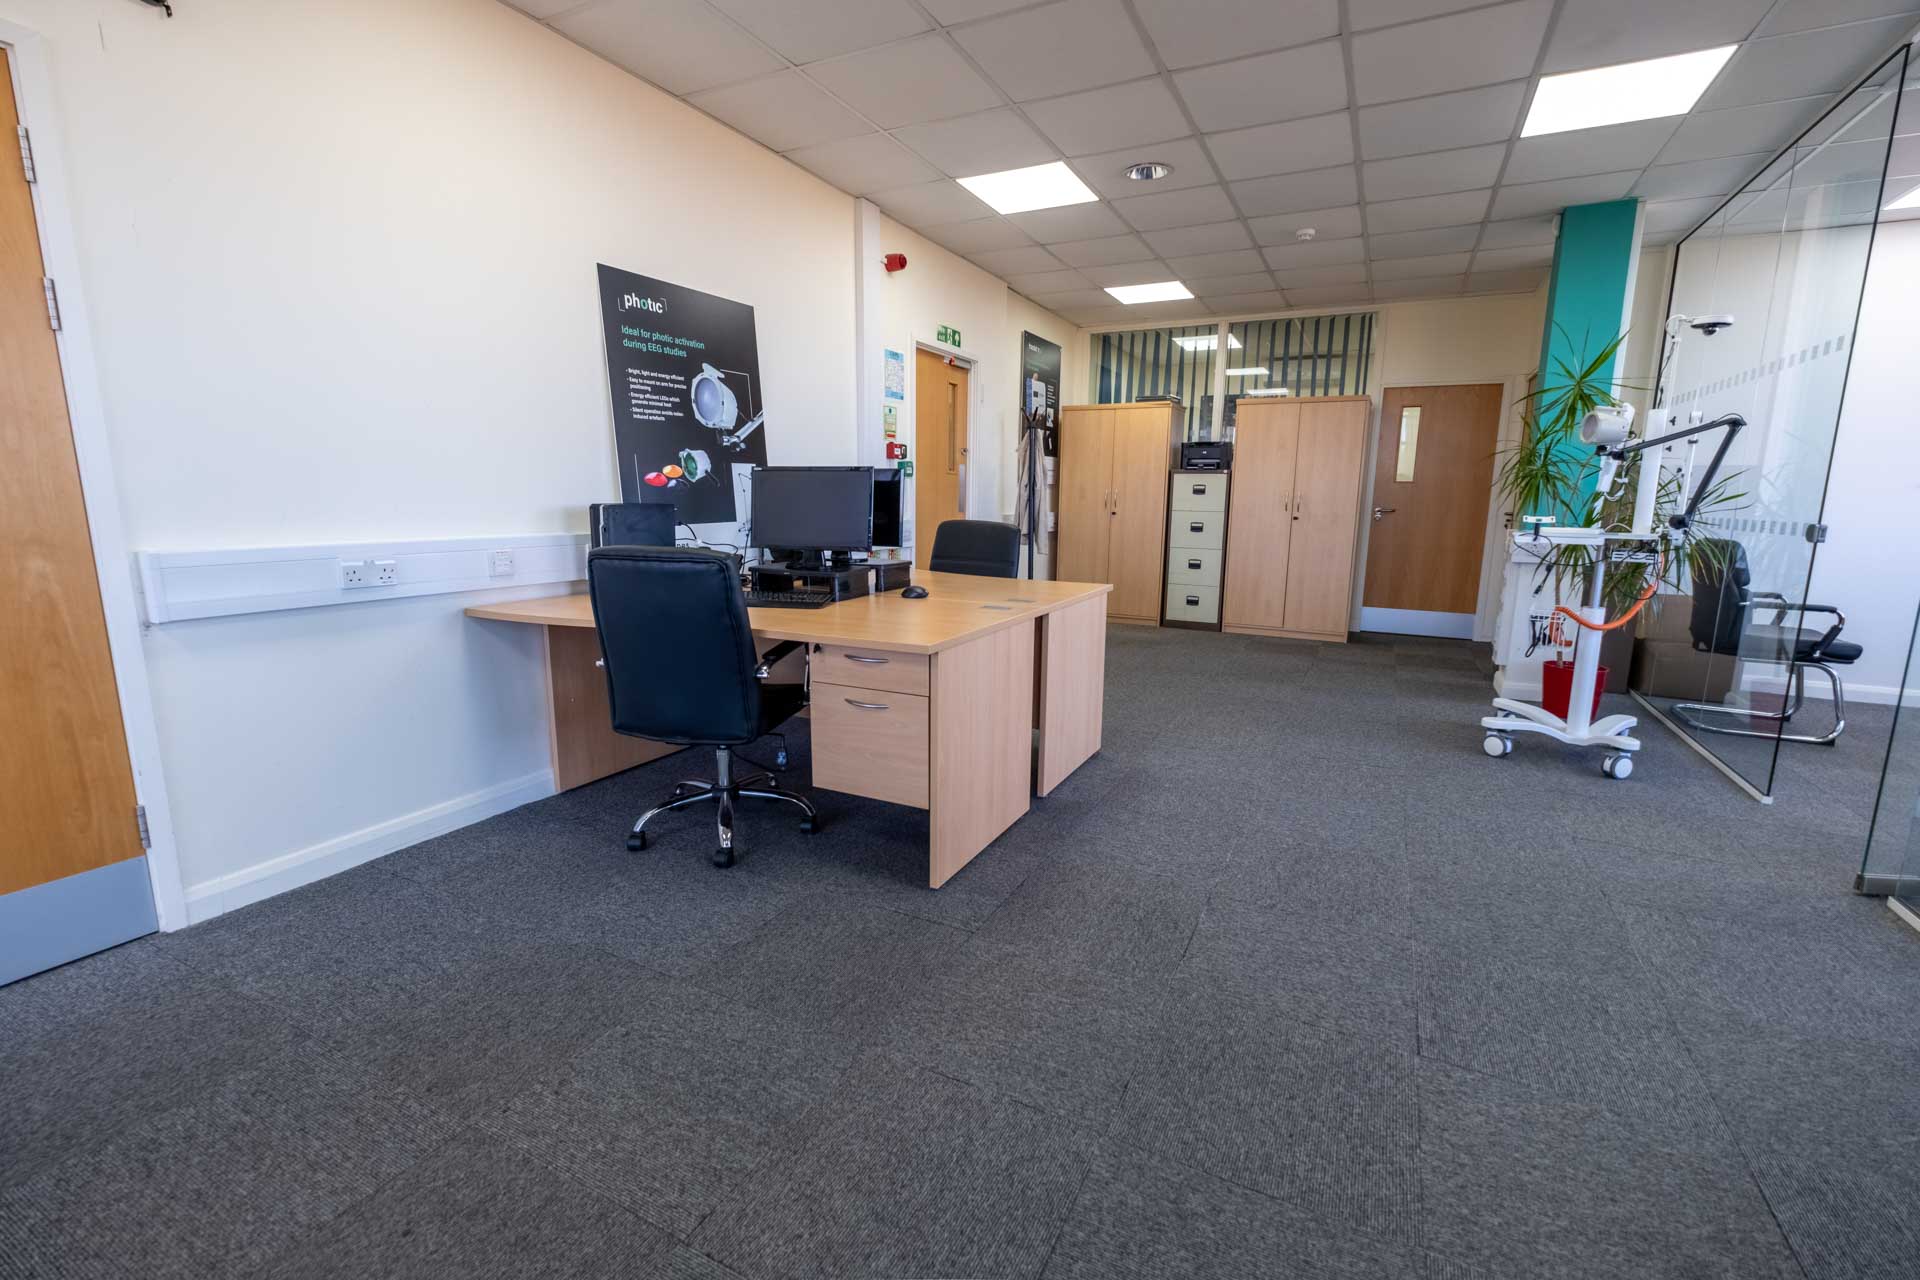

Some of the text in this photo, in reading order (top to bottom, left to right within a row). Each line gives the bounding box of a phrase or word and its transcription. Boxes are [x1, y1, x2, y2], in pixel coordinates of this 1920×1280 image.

[624, 292, 663, 313] photic
[621, 324, 705, 350] Ideal for photic activation
[622, 338, 687, 357] during EEG studies
